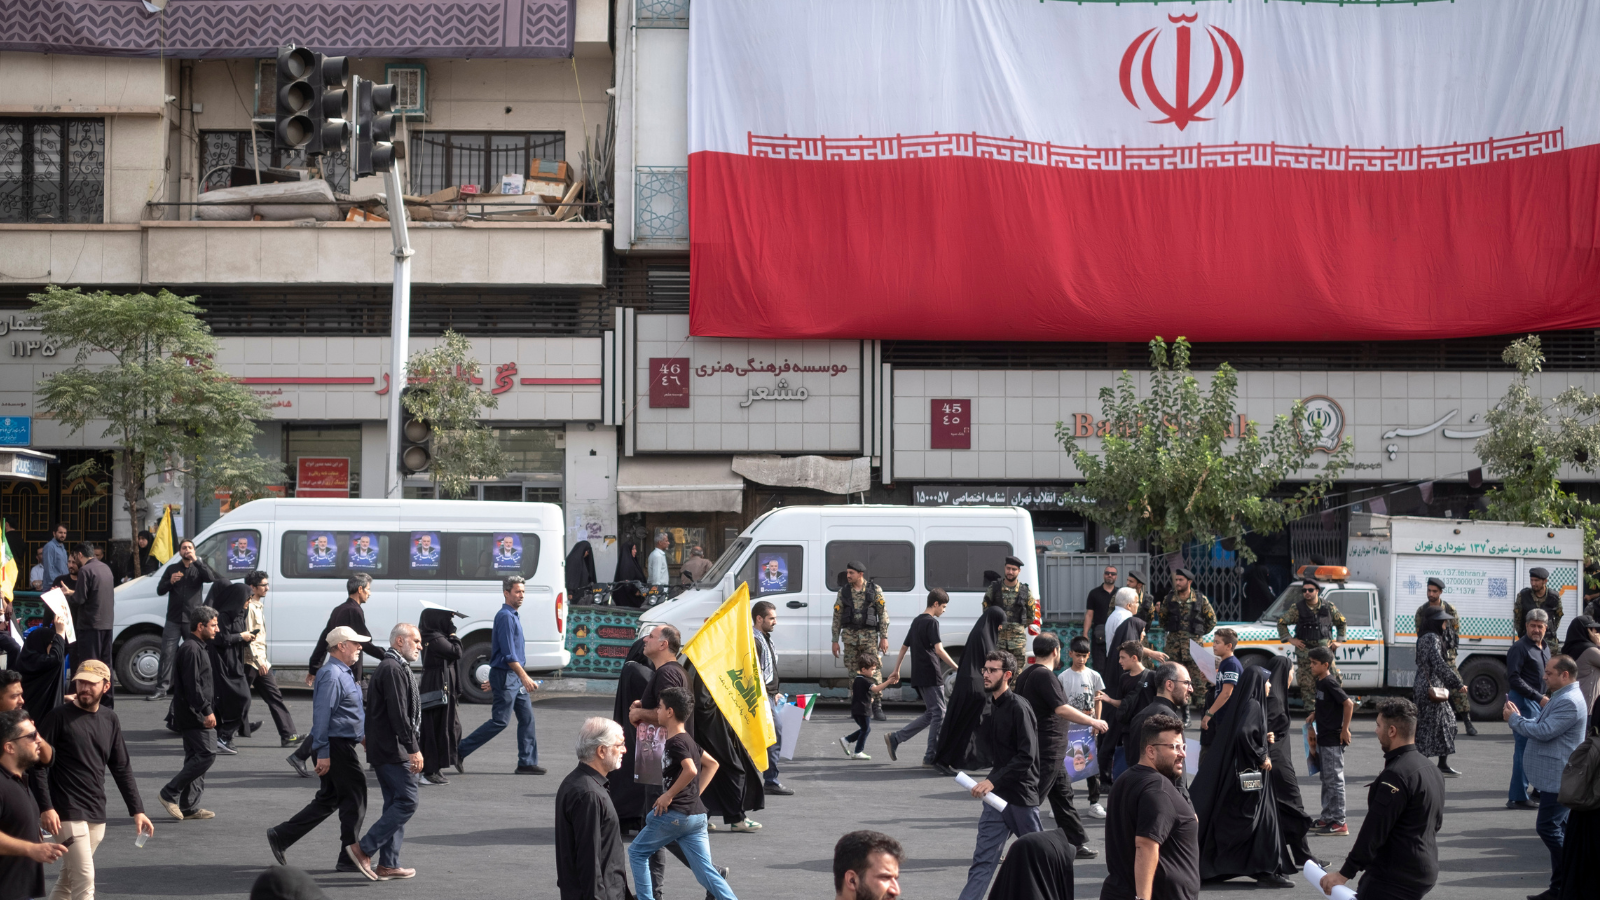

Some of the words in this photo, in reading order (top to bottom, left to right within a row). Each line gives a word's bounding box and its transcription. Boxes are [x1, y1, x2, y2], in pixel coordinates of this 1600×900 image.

[0, 315, 49, 336] تمان
[11, 341, 56, 356] ۱۱۳۵
[659, 364, 680, 374] 46
[695, 361, 734, 377] هنری
[736, 358, 791, 377] فرهنگی
[793, 363, 848, 377] موسسه
[739, 378, 809, 408] مشعر
[942, 403, 961, 414] 45
[1162, 413, 1250, 438] Sah
[916, 491, 949, 503] ۱۵۰۰۰۵۷
[952, 492, 985, 505] اختصاصی
[986, 492, 1006, 503] شناسه
[1010, 491, 1032, 506] تهران
[1033, 491, 1056, 506] انقلاب
[1415, 540, 1433, 552] تهران
[1435, 541, 1466, 553] شهرداری
[1488, 543, 1509, 555] شهری
[1511, 544, 1538, 555] مدیریت
[1539, 544, 1562, 554] سامانه
[1423, 569, 1487, 577] www.137.tehran.ir
